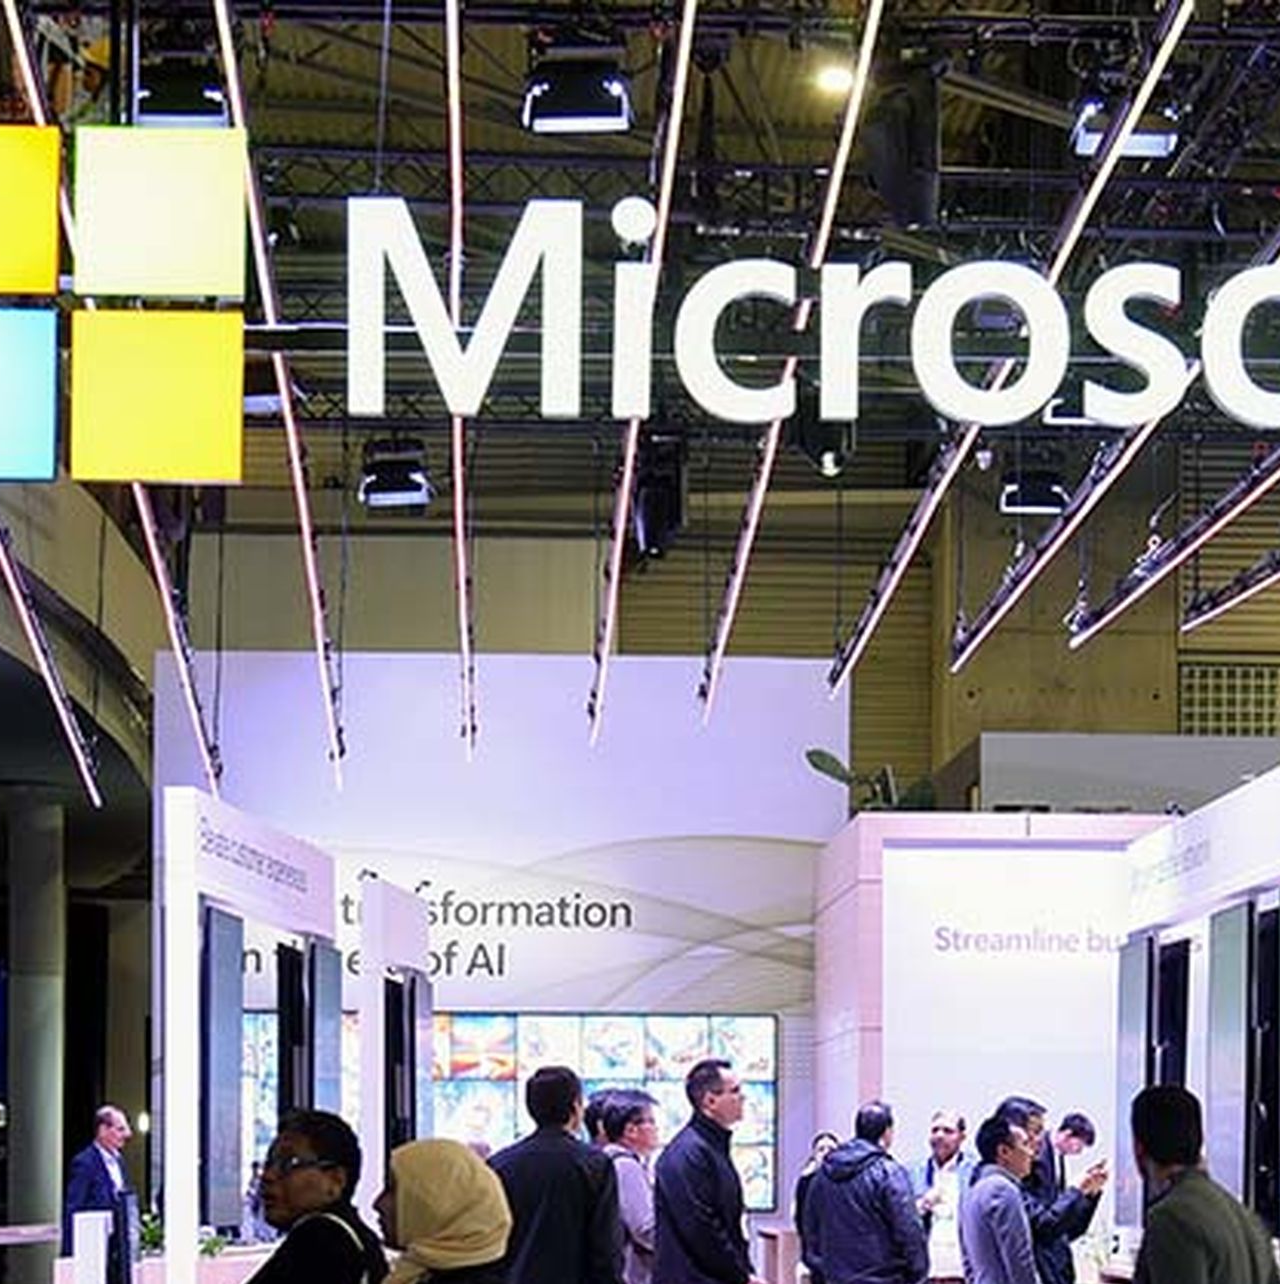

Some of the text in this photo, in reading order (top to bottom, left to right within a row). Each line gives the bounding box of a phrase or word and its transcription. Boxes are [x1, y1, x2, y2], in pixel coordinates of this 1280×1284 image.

[342, 891, 632, 928] tsformation
[934, 926, 1077, 952] Streamline
[466, 944, 504, 976] AI
